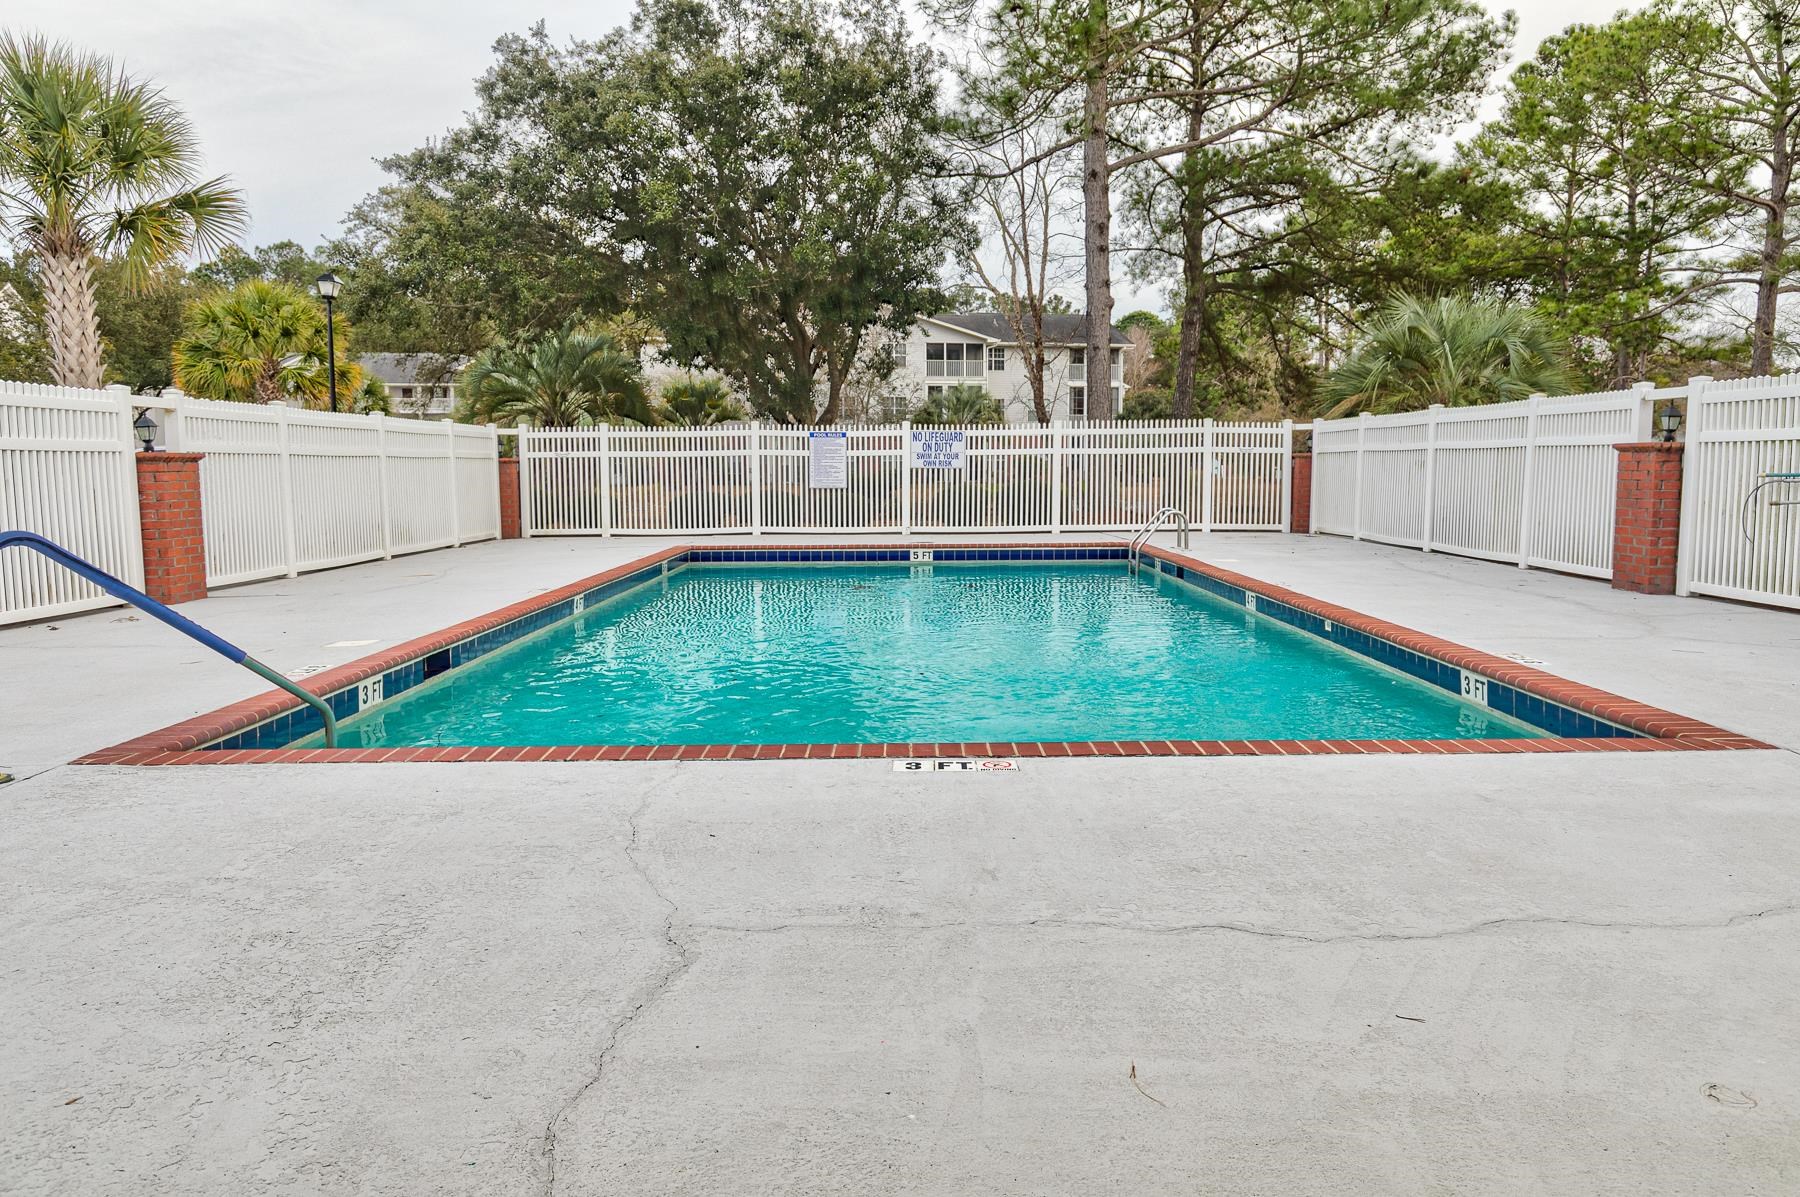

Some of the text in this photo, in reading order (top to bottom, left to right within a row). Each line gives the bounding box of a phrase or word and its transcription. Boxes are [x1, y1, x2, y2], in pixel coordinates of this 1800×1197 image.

[912, 431, 963, 442] NO LIFEGUARD
[922, 442, 953, 452] ON DUTY
[913, 551, 932, 560] 5 FT
[362, 679, 382, 705] 3 FT
[1464, 675, 1486, 701] 3 FT
[905, 761, 922, 770] 3
